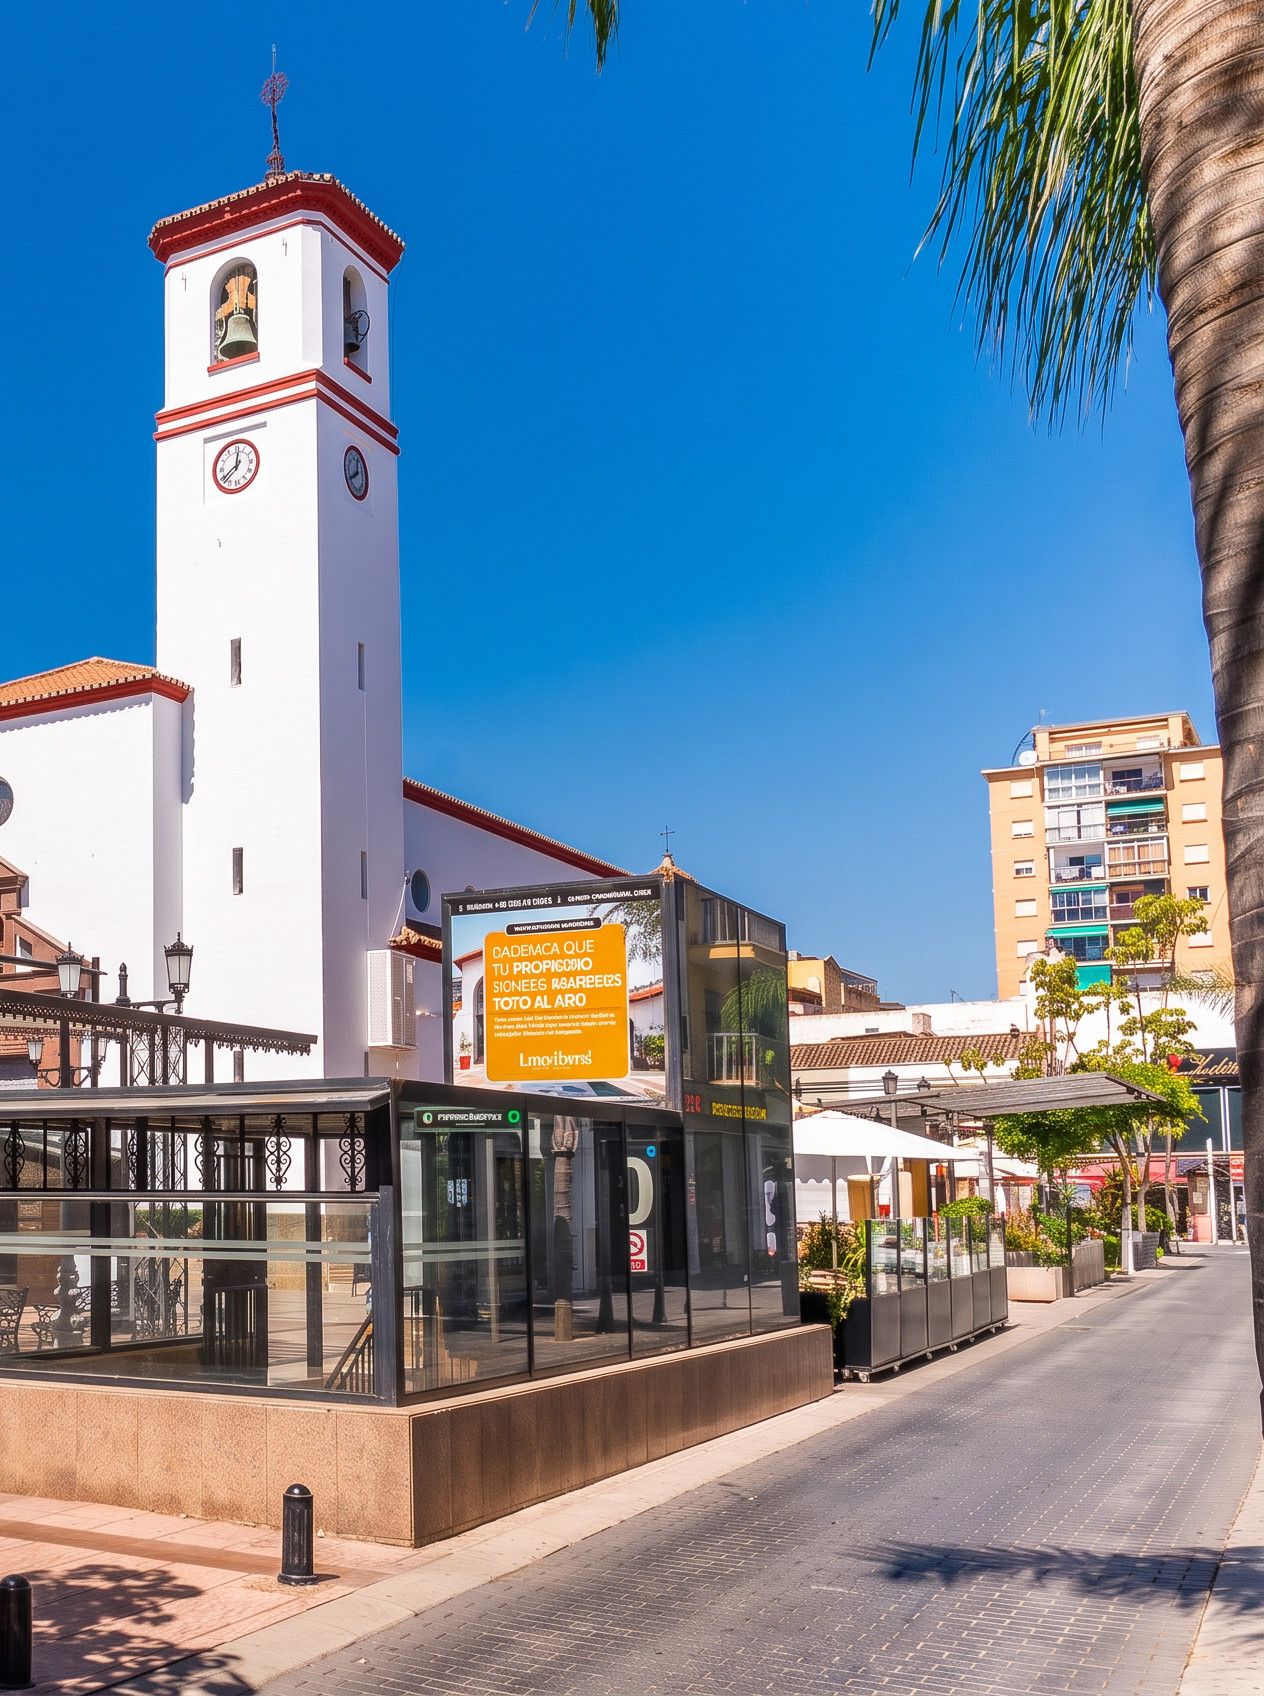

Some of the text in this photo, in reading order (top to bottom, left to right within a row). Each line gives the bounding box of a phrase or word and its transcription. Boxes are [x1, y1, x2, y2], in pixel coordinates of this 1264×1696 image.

[564, 940, 595, 955] QUE
[493, 963, 509, 976] TU
[493, 993, 587, 1011] TOTO AL ARO
